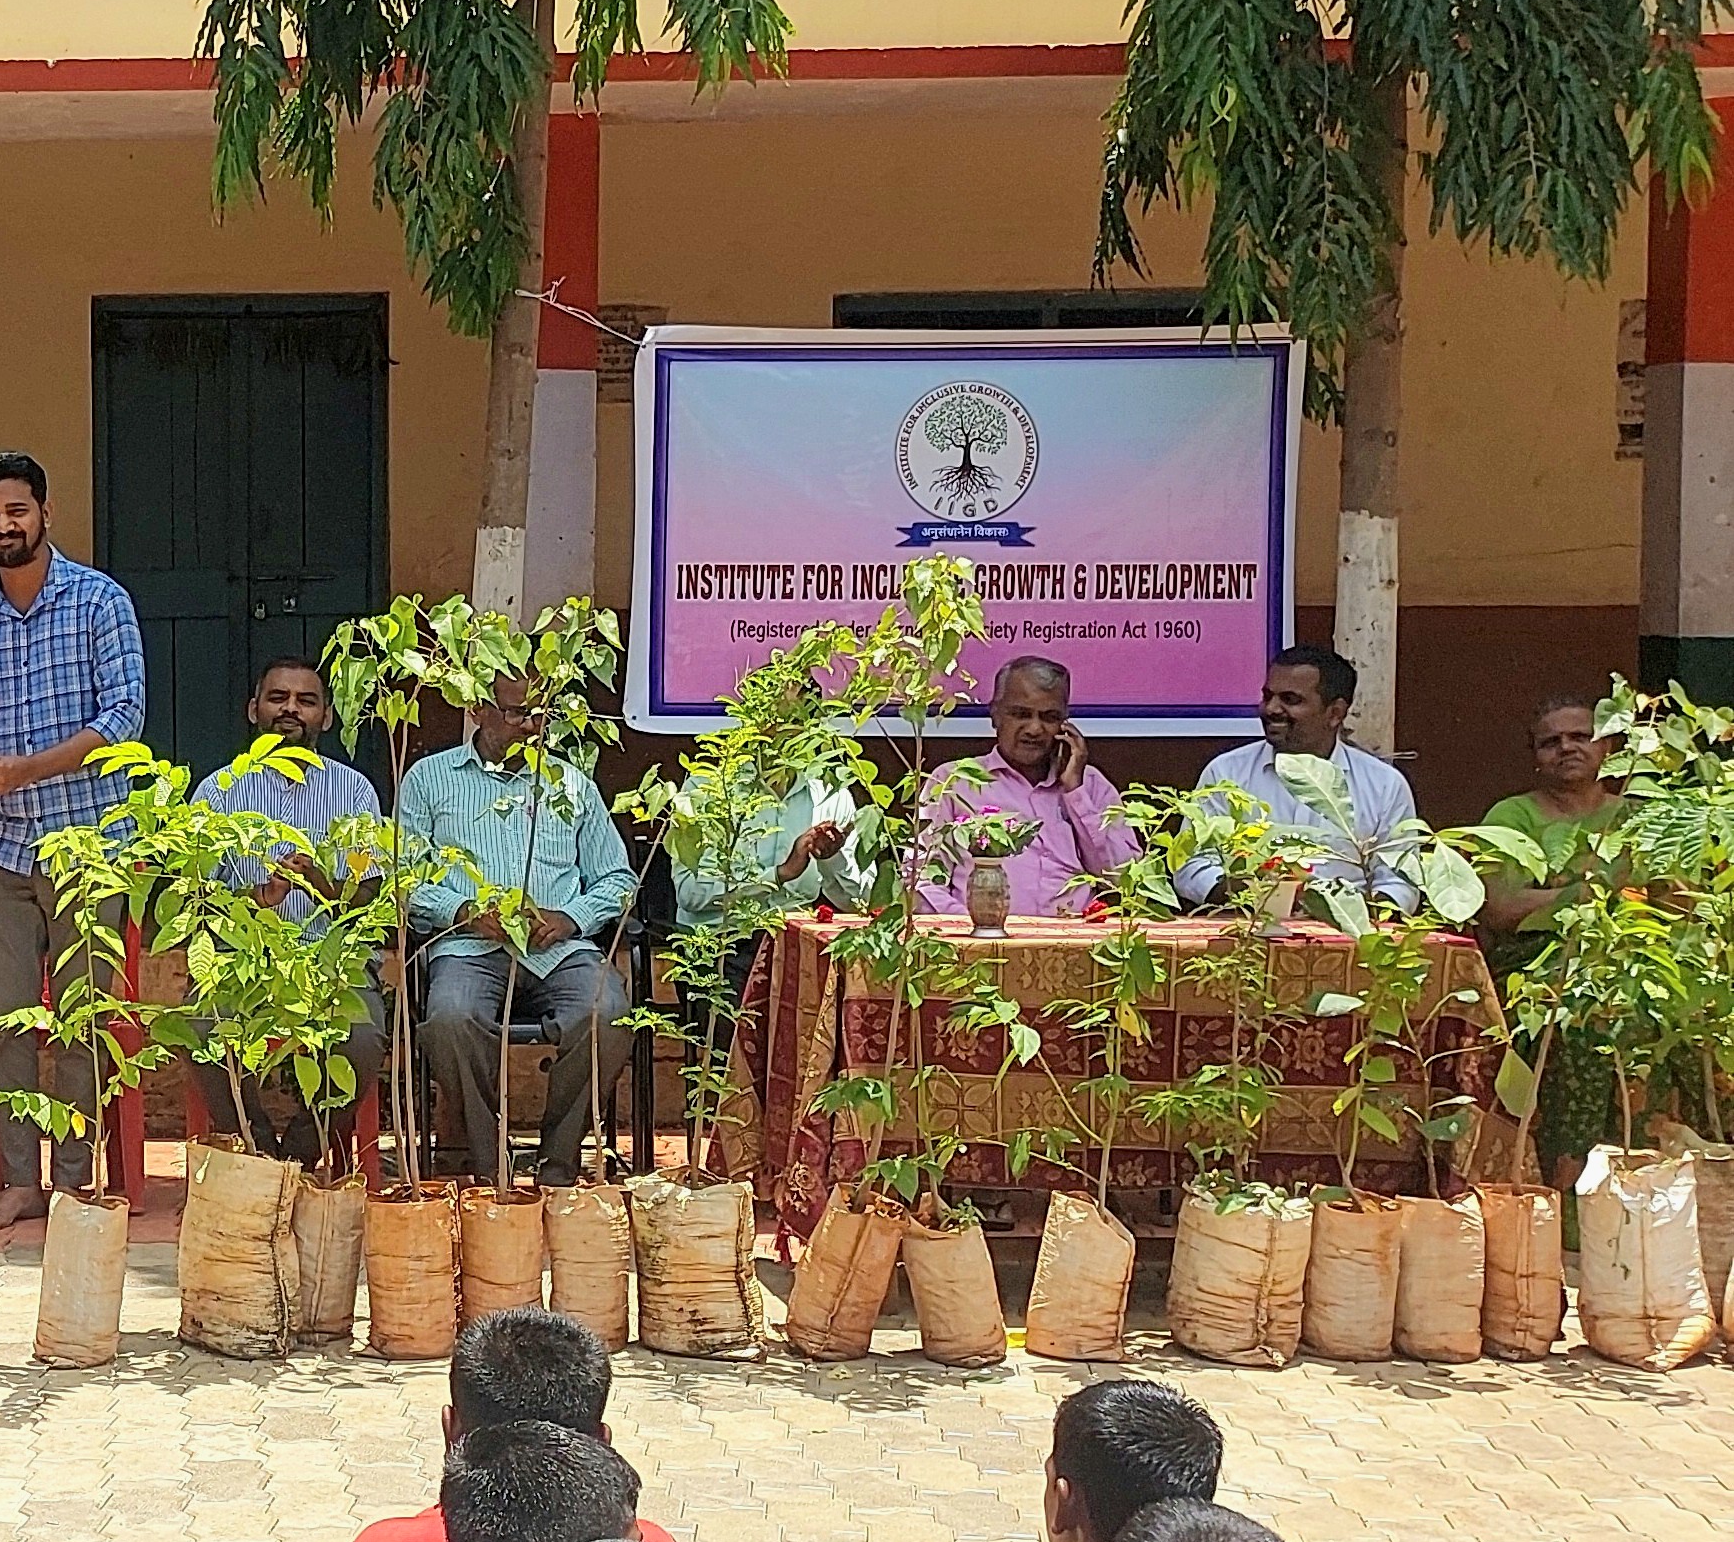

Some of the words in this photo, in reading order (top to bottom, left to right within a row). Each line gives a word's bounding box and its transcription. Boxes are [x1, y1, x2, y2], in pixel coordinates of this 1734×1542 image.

[915, 384, 967, 418] INCLUSIVE
[969, 384, 1015, 411] GROWTH
[904, 415, 918, 436] FOR
[899, 437, 919, 491] INSTITUTE
[1015, 415, 1035, 490] DEVELOPMENT
[676, 563, 795, 600] INSTITUTE
[802, 563, 844, 600] FOR
[974, 563, 1066, 600] GROWTH
[1073, 563, 1087, 600] &
[1095, 563, 1258, 600] DEVELOPMENT
[1022, 620, 1116, 643] Registration
[1121, 620, 1147, 639] Act
[1154, 620, 1202, 643] 1960)
